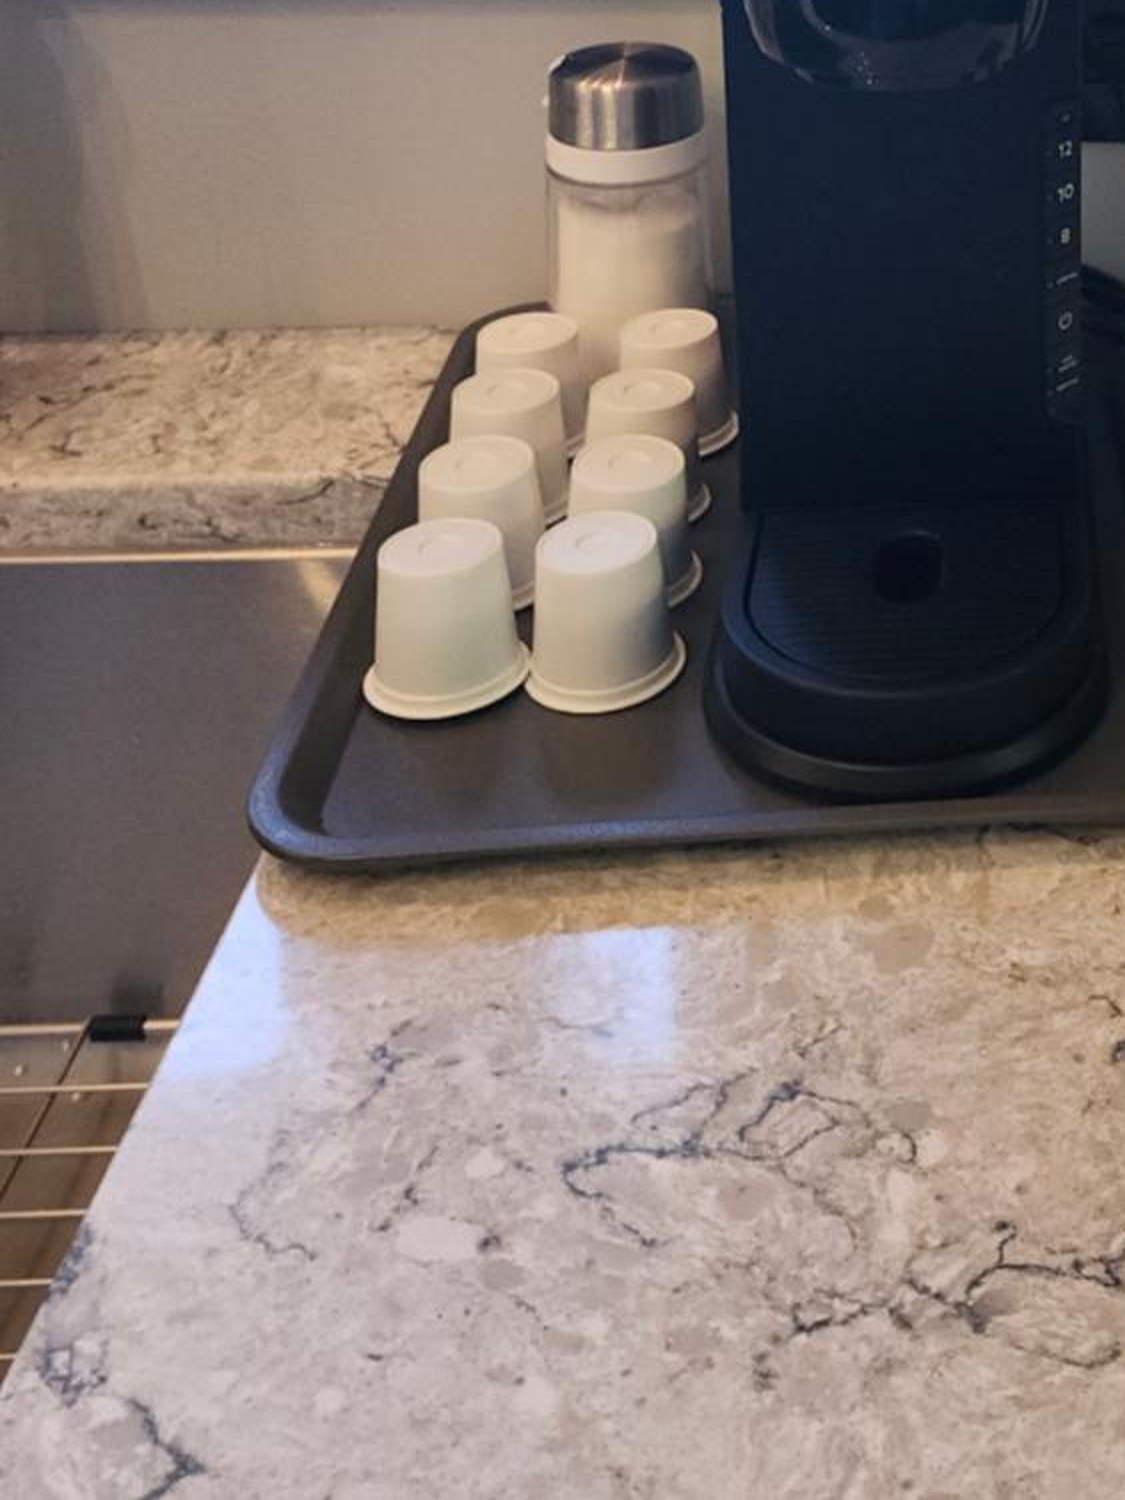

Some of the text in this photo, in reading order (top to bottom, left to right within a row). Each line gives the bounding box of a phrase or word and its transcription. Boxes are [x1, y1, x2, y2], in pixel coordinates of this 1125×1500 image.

[1058, 141, 1073, 157] 12
[1058, 184, 1075, 201] 10
[1060, 227, 1071, 244] 8
